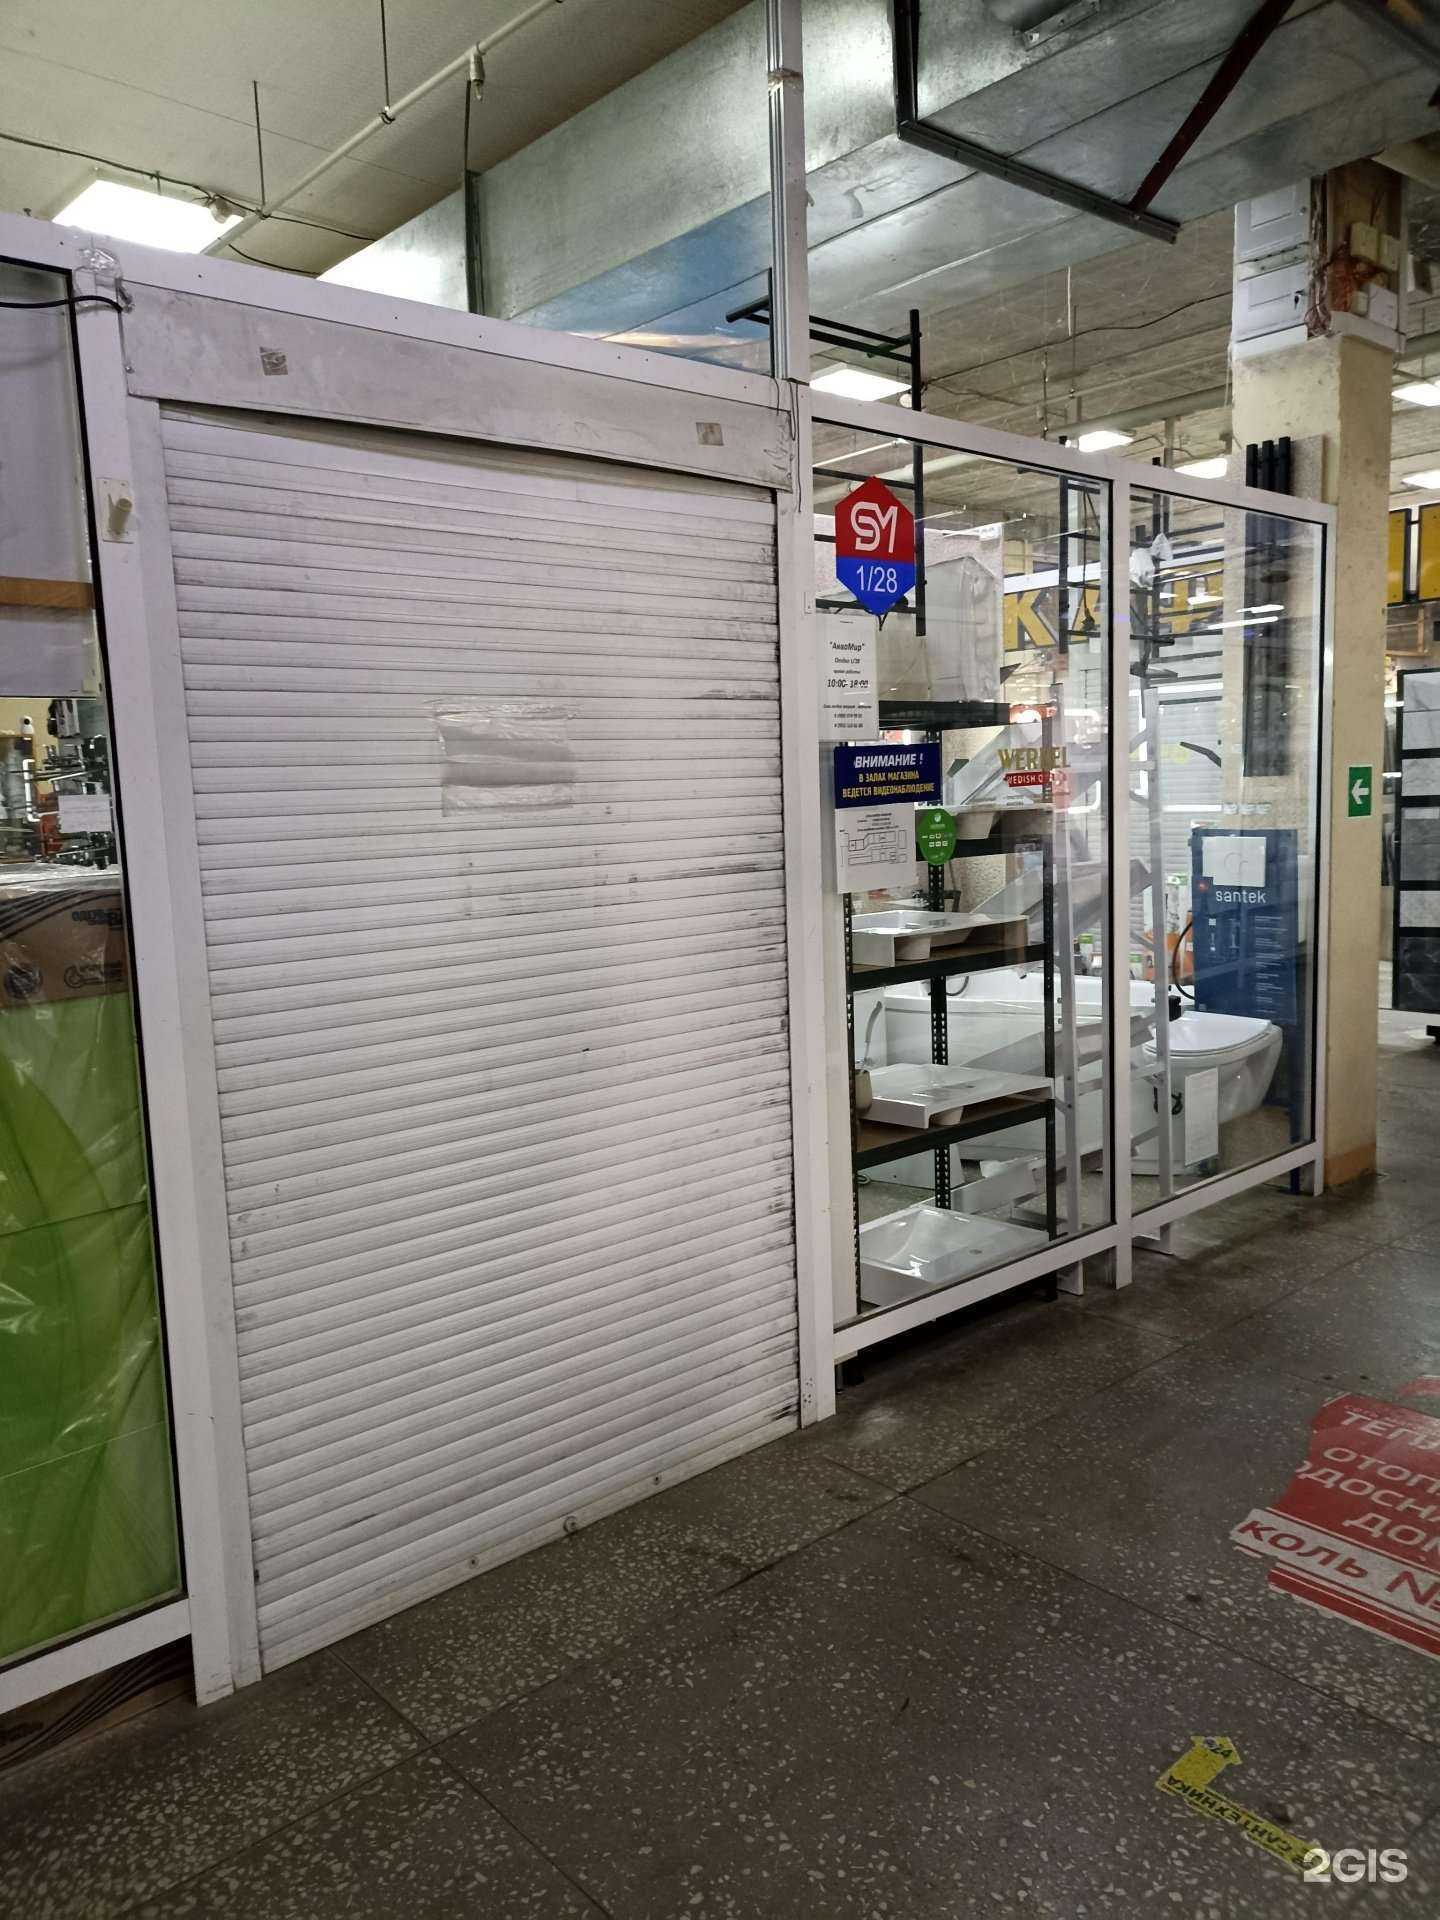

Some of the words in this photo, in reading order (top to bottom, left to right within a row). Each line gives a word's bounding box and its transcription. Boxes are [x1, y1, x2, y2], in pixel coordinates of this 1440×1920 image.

[856, 565, 898, 593] 1/28
[854, 754, 916, 768] ВНИМАНИЕ
[858, 773, 864, 783] В
[865, 773, 887, 782] ЗАЛАХ
[887, 770, 919, 781] МАГАЗИНА
[842, 786, 872, 798] ВЕДЕТСЯ
[873, 782, 935, 797] ВИДЕОНАБЛЮДЕНИЕ
[1215, 890, 1267, 904] santek
